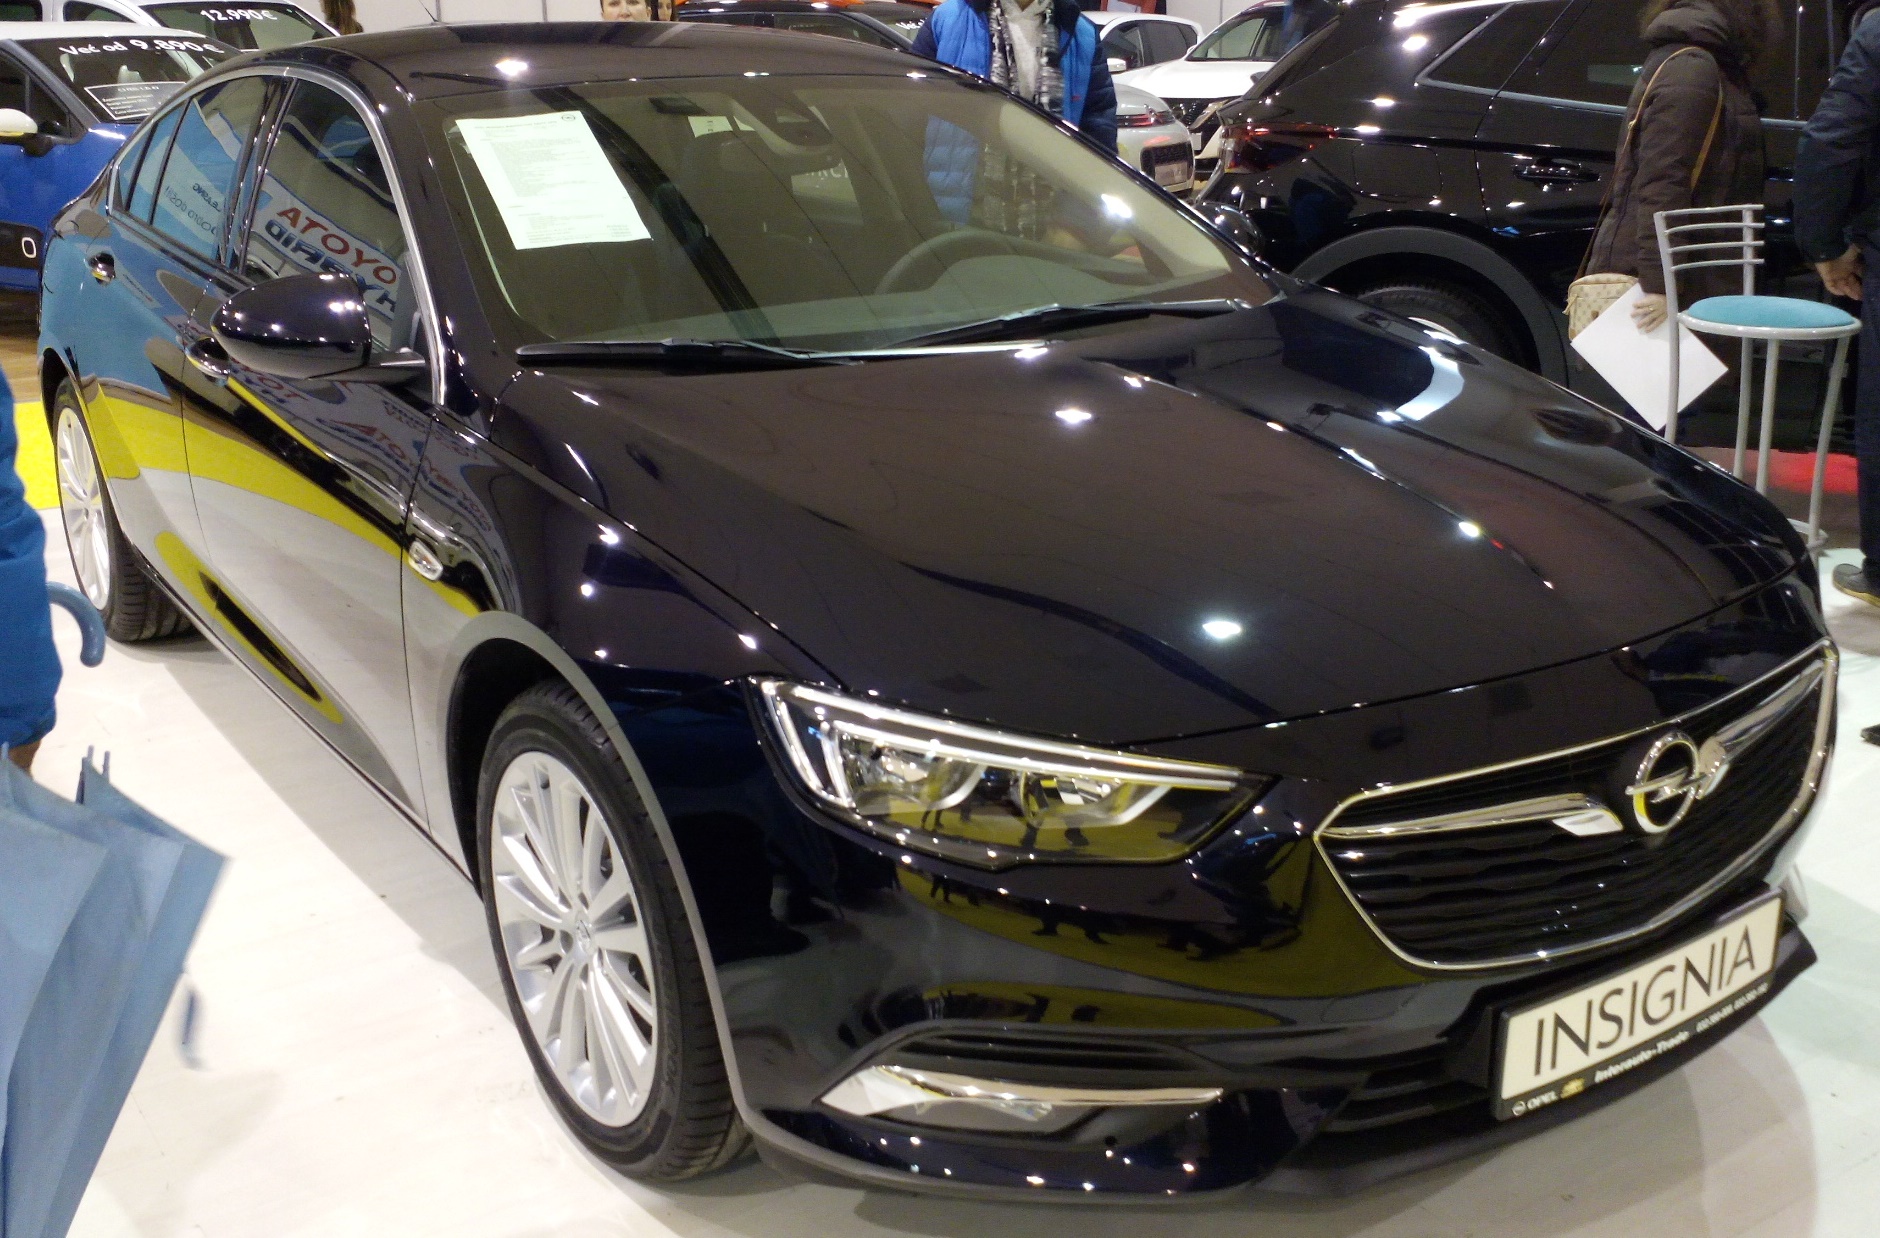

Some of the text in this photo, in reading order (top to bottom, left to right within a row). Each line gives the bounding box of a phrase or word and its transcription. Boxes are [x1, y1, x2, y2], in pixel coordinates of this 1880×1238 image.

[200, 9, 278, 22] 12.990€
[102, 41, 128, 52] od
[1533, 924, 1756, 1077] INSIGNIA
